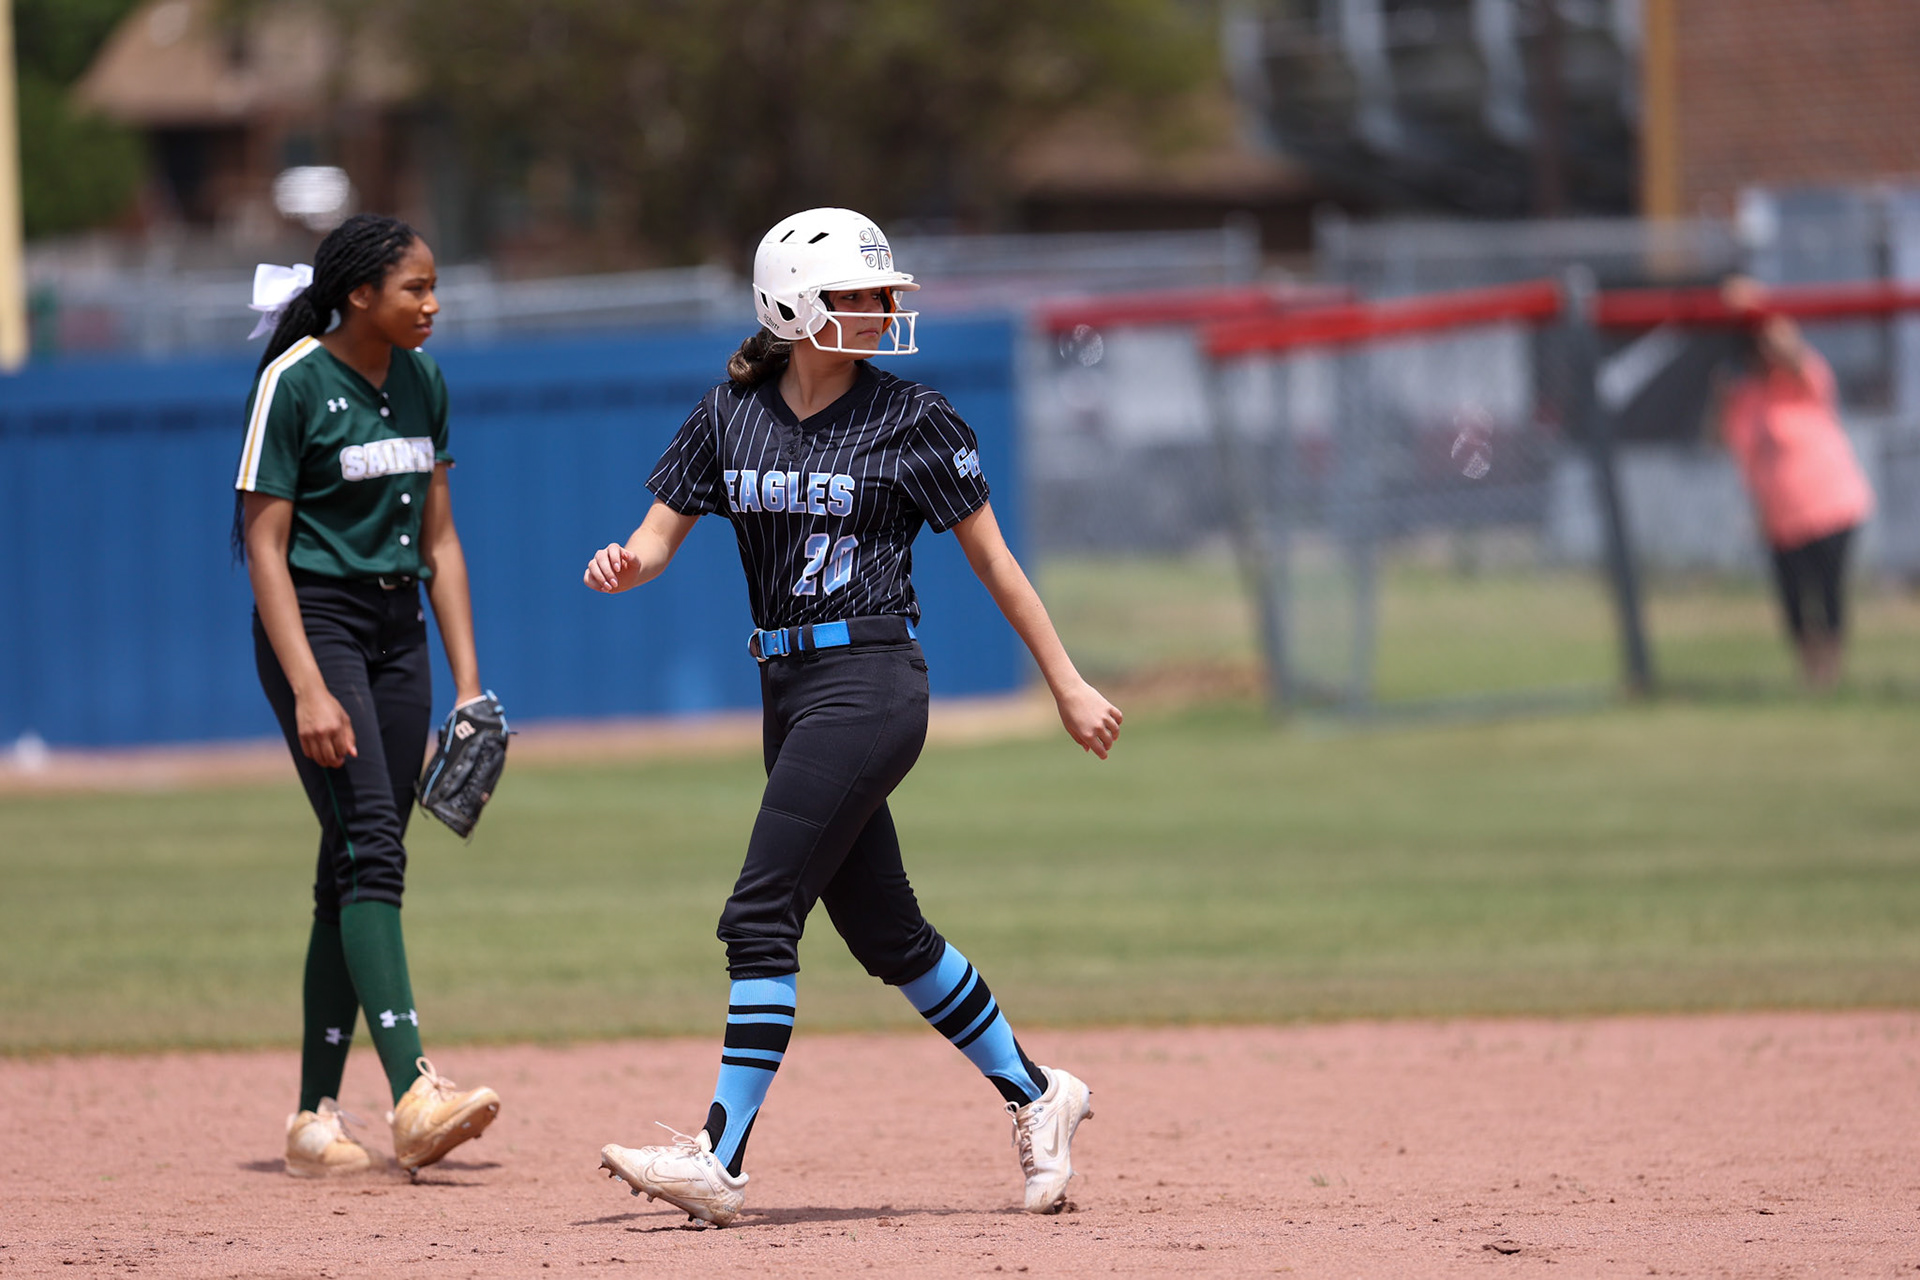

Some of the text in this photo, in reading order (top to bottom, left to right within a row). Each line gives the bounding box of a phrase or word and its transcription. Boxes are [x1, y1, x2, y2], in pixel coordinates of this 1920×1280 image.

[339, 436, 435, 482] SAINT
[723, 469, 856, 517] EAGLES
[792, 533, 859, 596] 20
